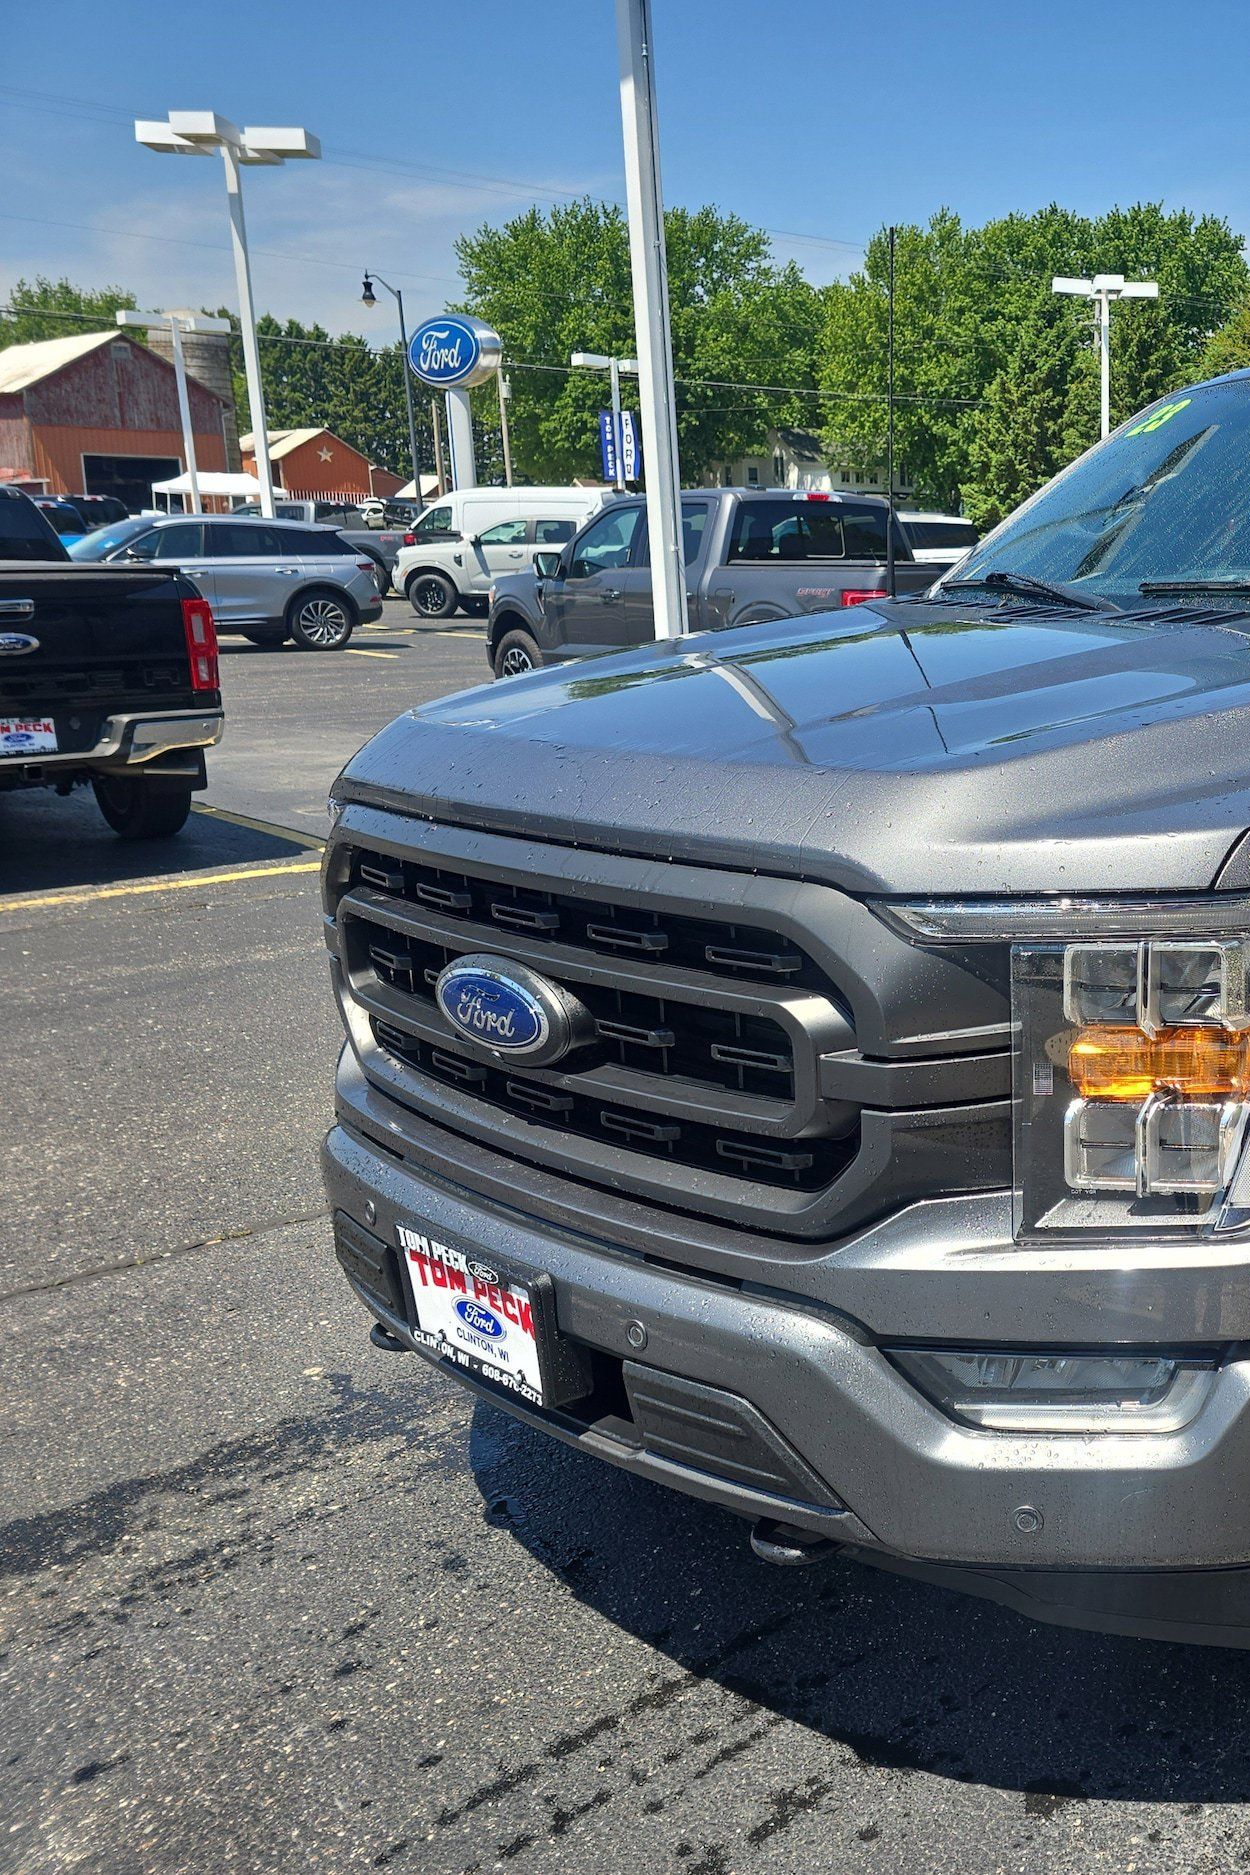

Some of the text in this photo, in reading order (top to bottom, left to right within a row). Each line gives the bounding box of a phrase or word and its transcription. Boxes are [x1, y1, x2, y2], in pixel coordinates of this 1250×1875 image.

[420, 330, 462, 372] Ford
[605, 415, 616, 477] TOM PECK
[624, 418, 633, 474] FORD
[14, 722, 54, 734] PECK
[457, 984, 515, 1038] Ford
[396, 1225, 469, 1276] TOM PECK
[410, 1249, 536, 1341] TOM PECK
[465, 1303, 495, 1334] Ford
[456, 1327, 510, 1363] CLINTON, WI
[457, 1350, 470, 1368] WI
